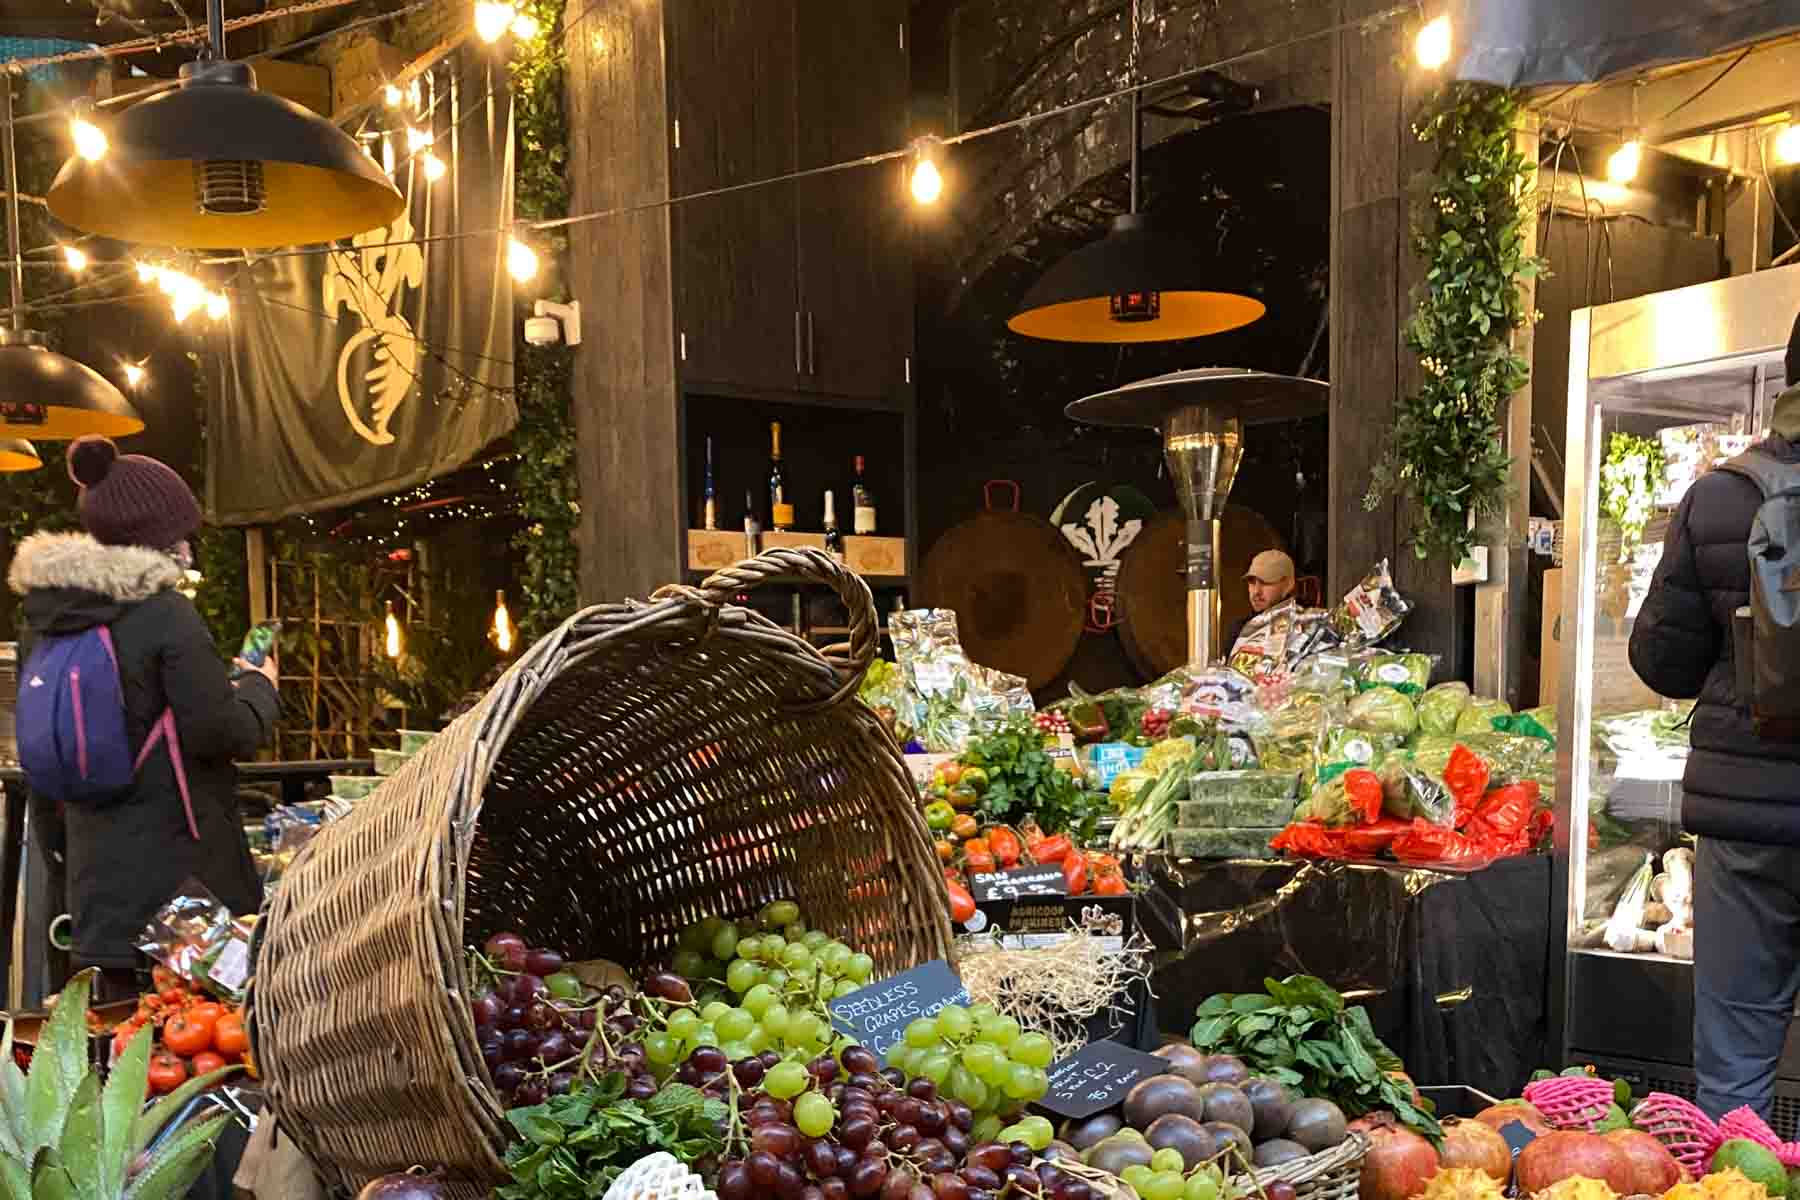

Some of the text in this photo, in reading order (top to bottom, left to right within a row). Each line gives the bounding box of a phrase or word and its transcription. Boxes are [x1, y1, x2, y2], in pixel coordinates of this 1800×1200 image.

[974, 871, 1009, 883] SAN
[834, 982, 918, 1022] SEEDLESS
[864, 1000, 920, 1033] GRAPES
